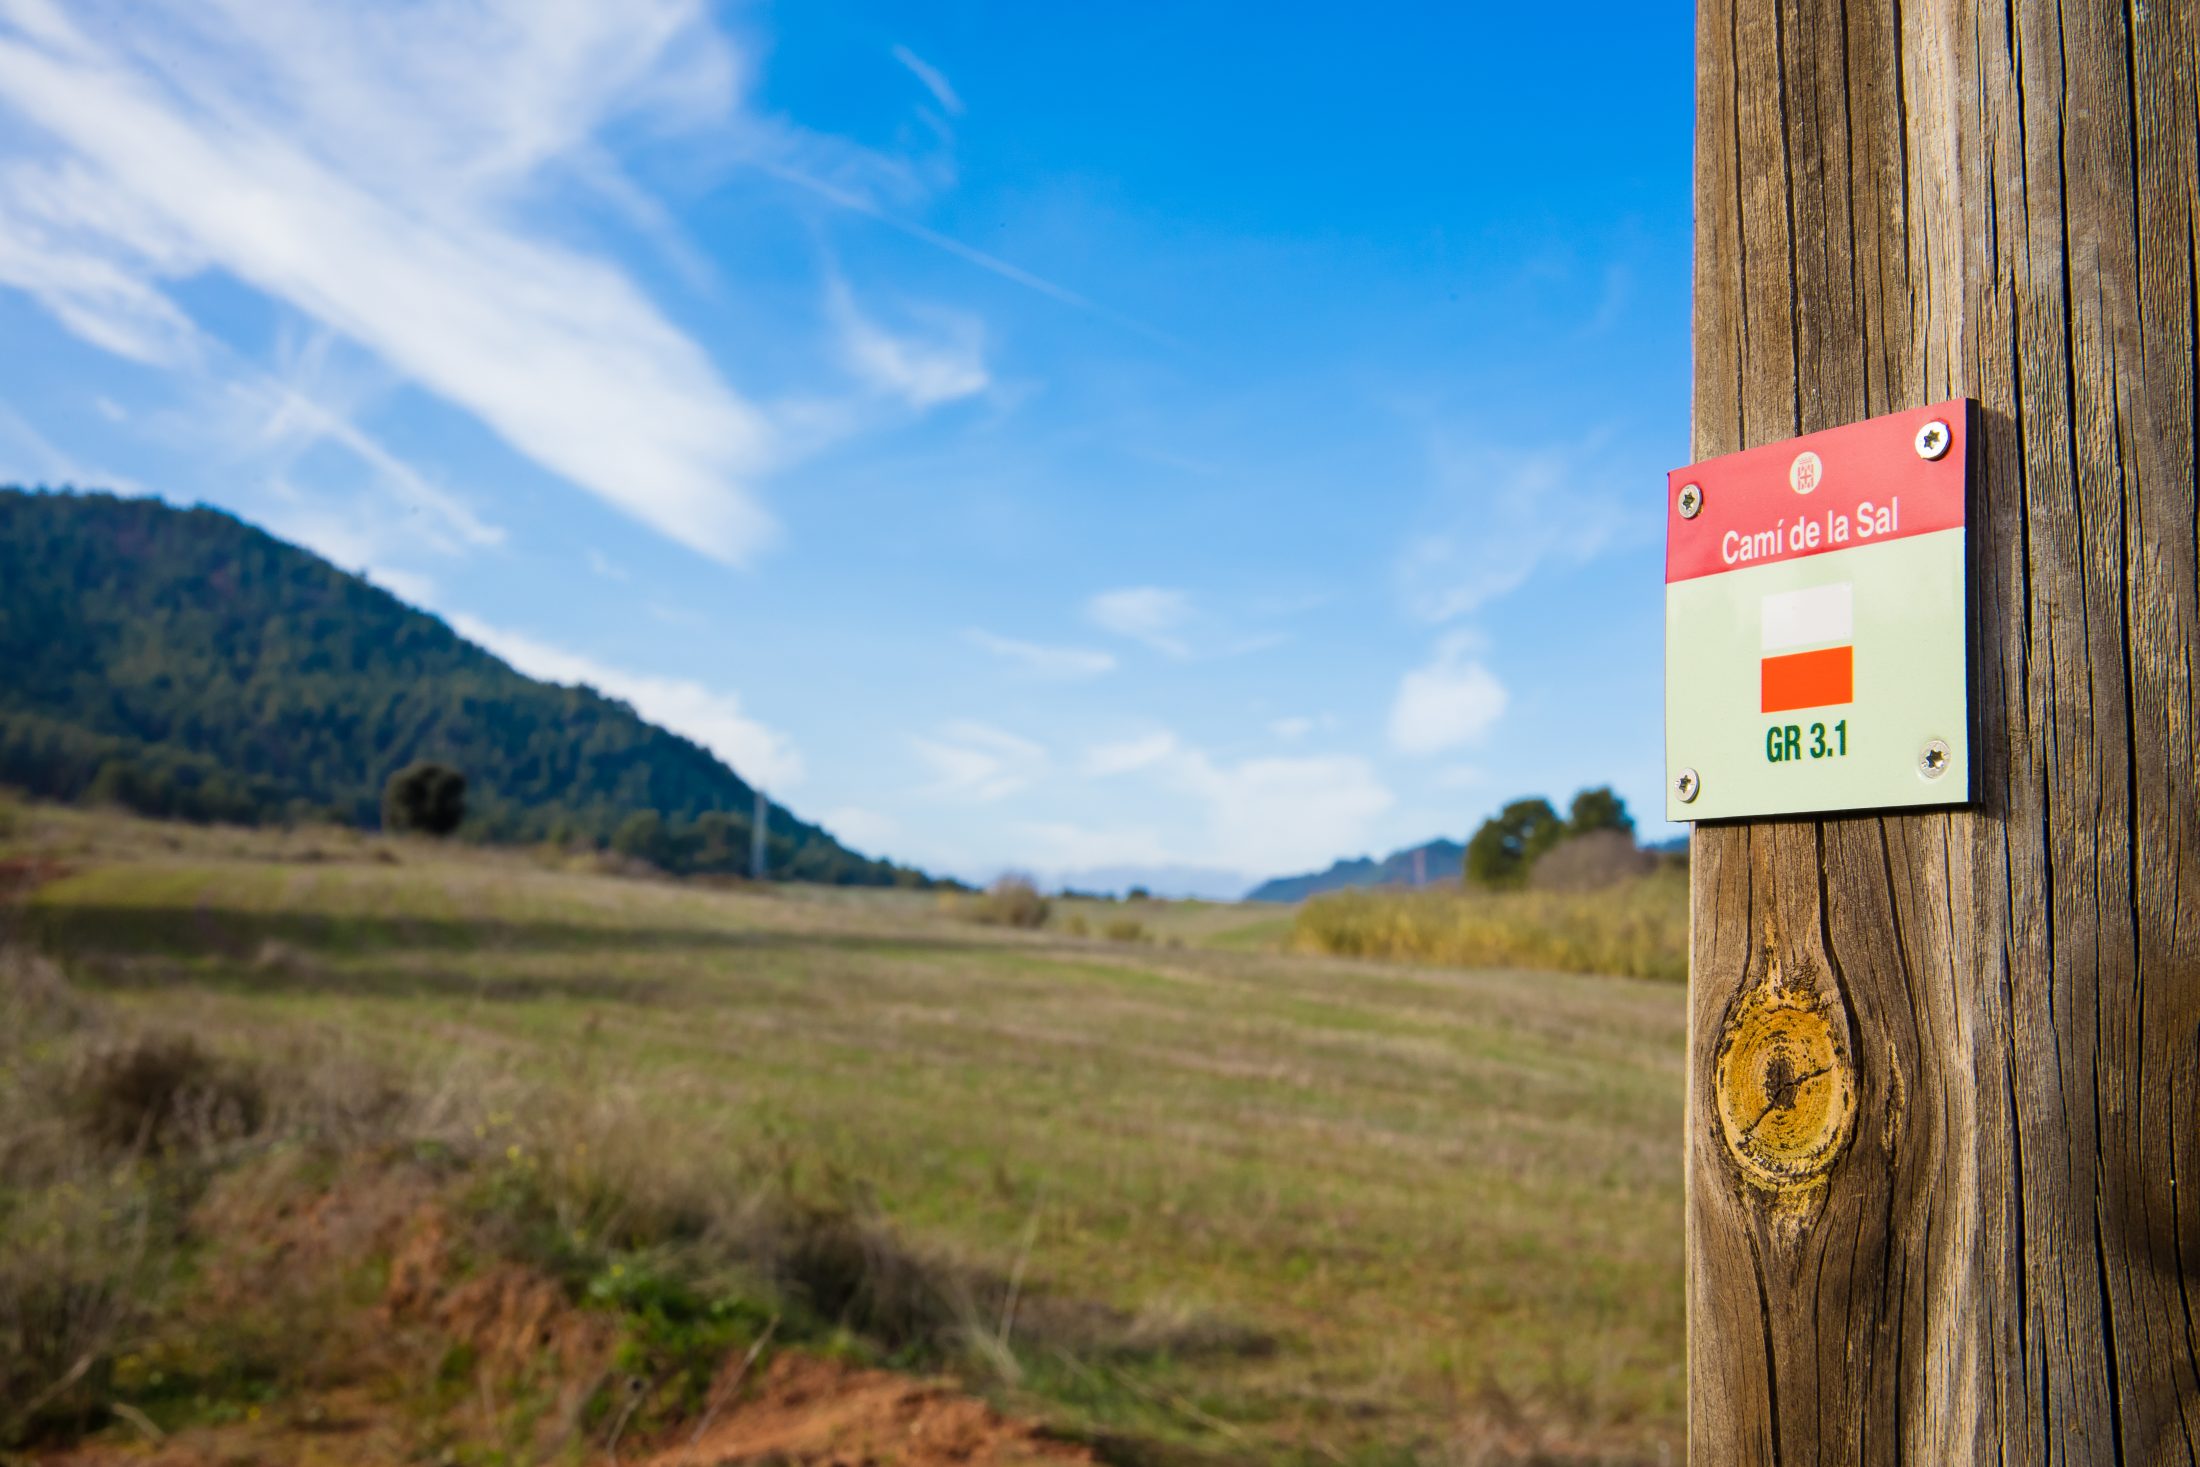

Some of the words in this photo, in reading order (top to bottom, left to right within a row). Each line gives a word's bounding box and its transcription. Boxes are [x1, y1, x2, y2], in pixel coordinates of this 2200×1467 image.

[1722, 519, 1783, 564] Camí
[1789, 516, 1820, 551] de
[1828, 508, 1849, 544] la
[1857, 496, 1898, 538] Sal
[1766, 724, 1801, 762] GR
[1810, 719, 1848, 759] 3.1
